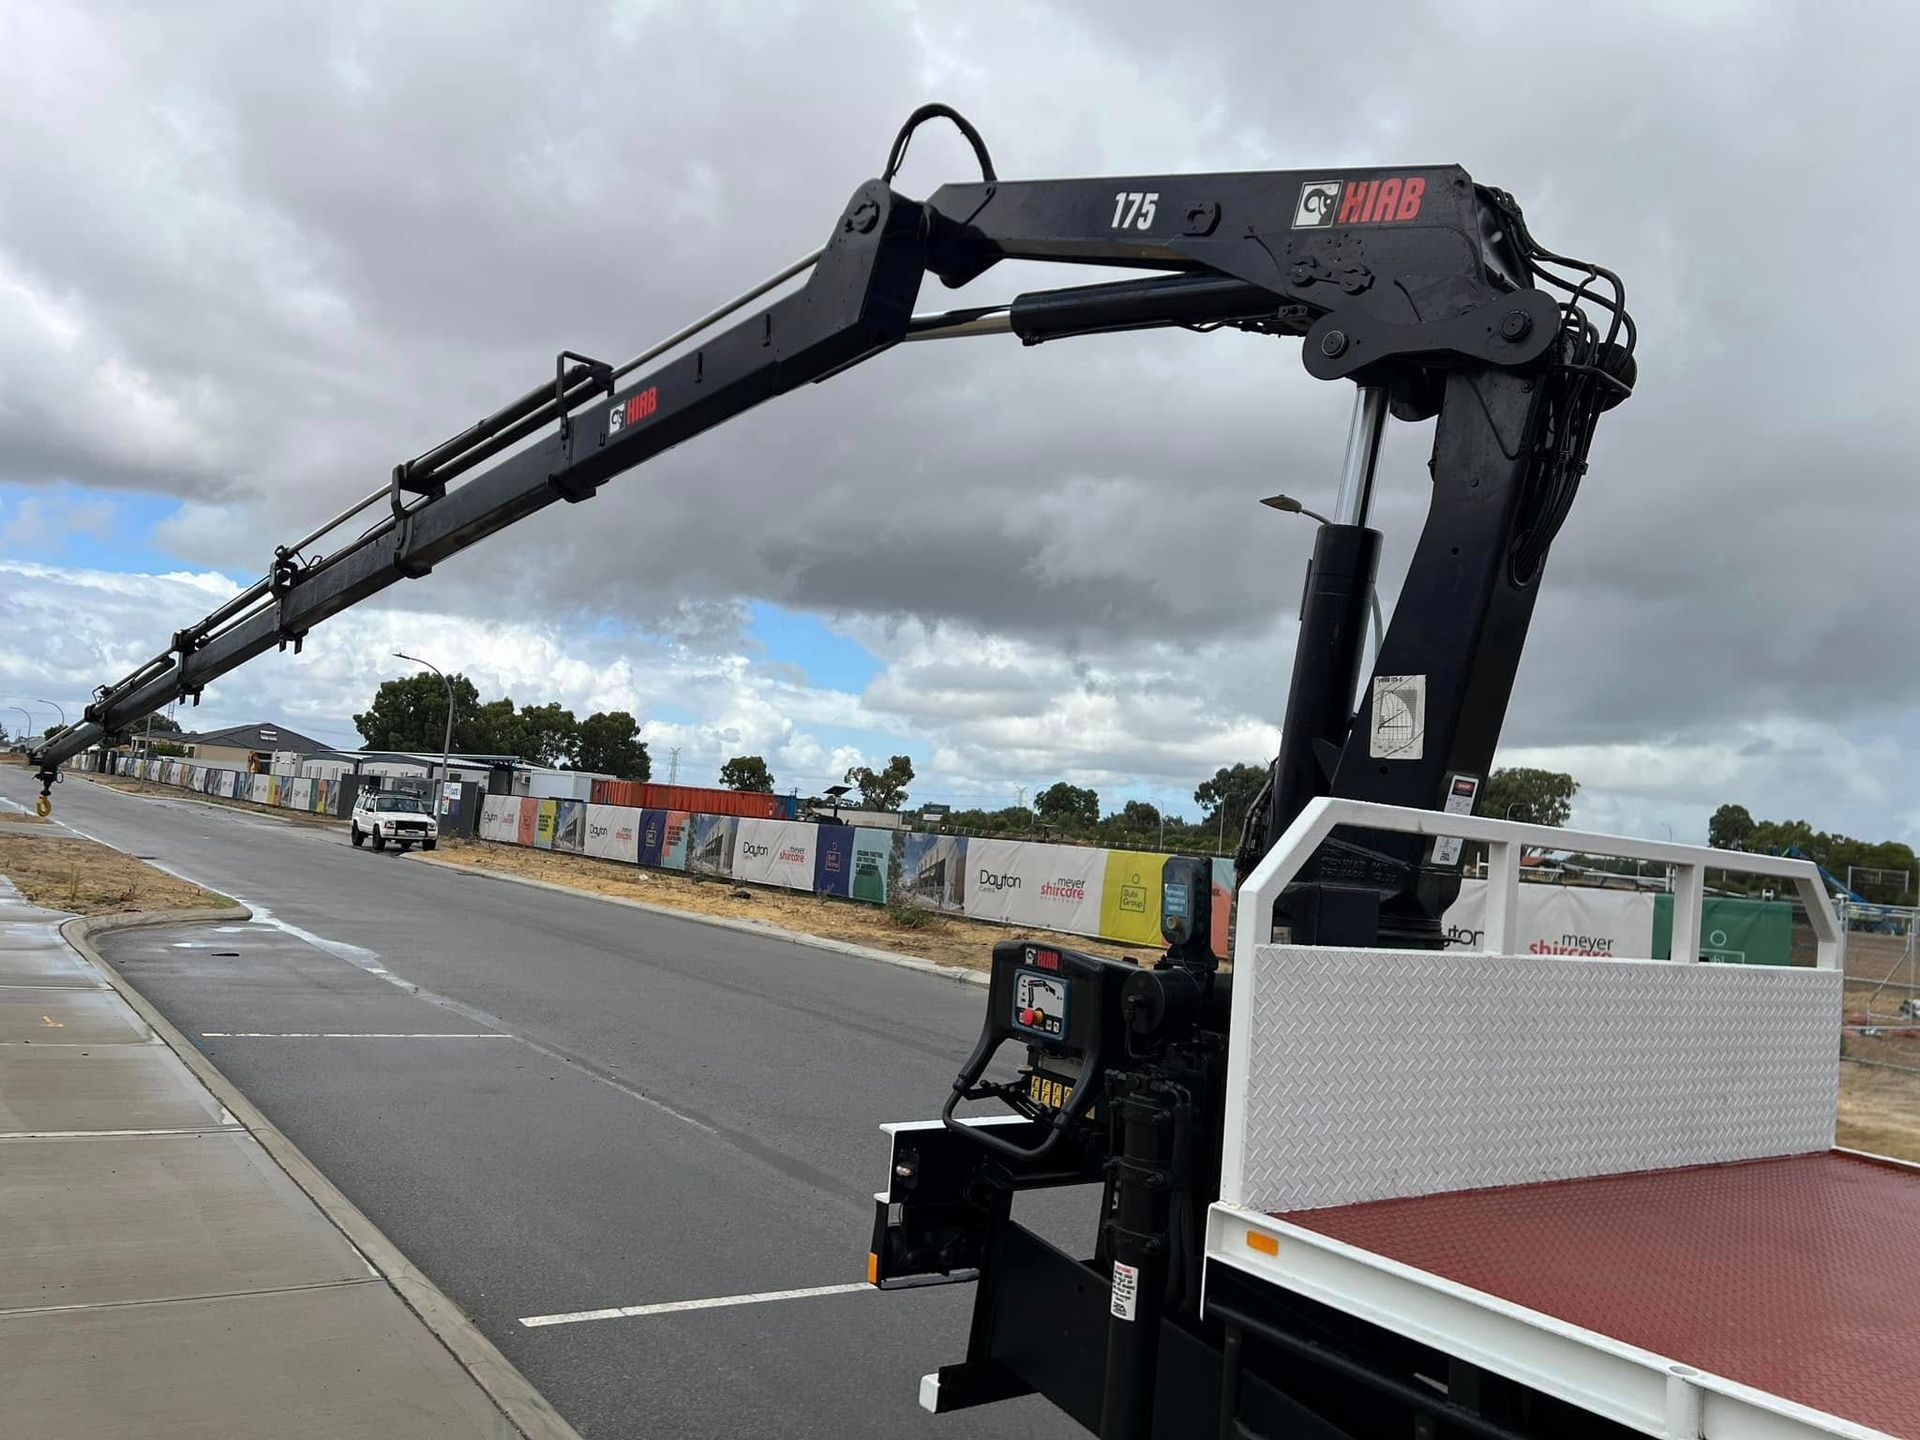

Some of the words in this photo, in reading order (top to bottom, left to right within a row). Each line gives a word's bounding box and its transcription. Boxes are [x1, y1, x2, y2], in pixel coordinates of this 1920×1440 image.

[1337, 177, 1426, 224] HIAB
[1111, 192, 1158, 231] 175
[627, 386, 657, 427] HIAB
[980, 869, 1021, 890] Dayton
[1057, 878, 1085, 890] meyer
[1040, 882, 1083, 899] shircore
[1562, 934, 1614, 951] meyer
[1037, 951, 1058, 970] HIAB
